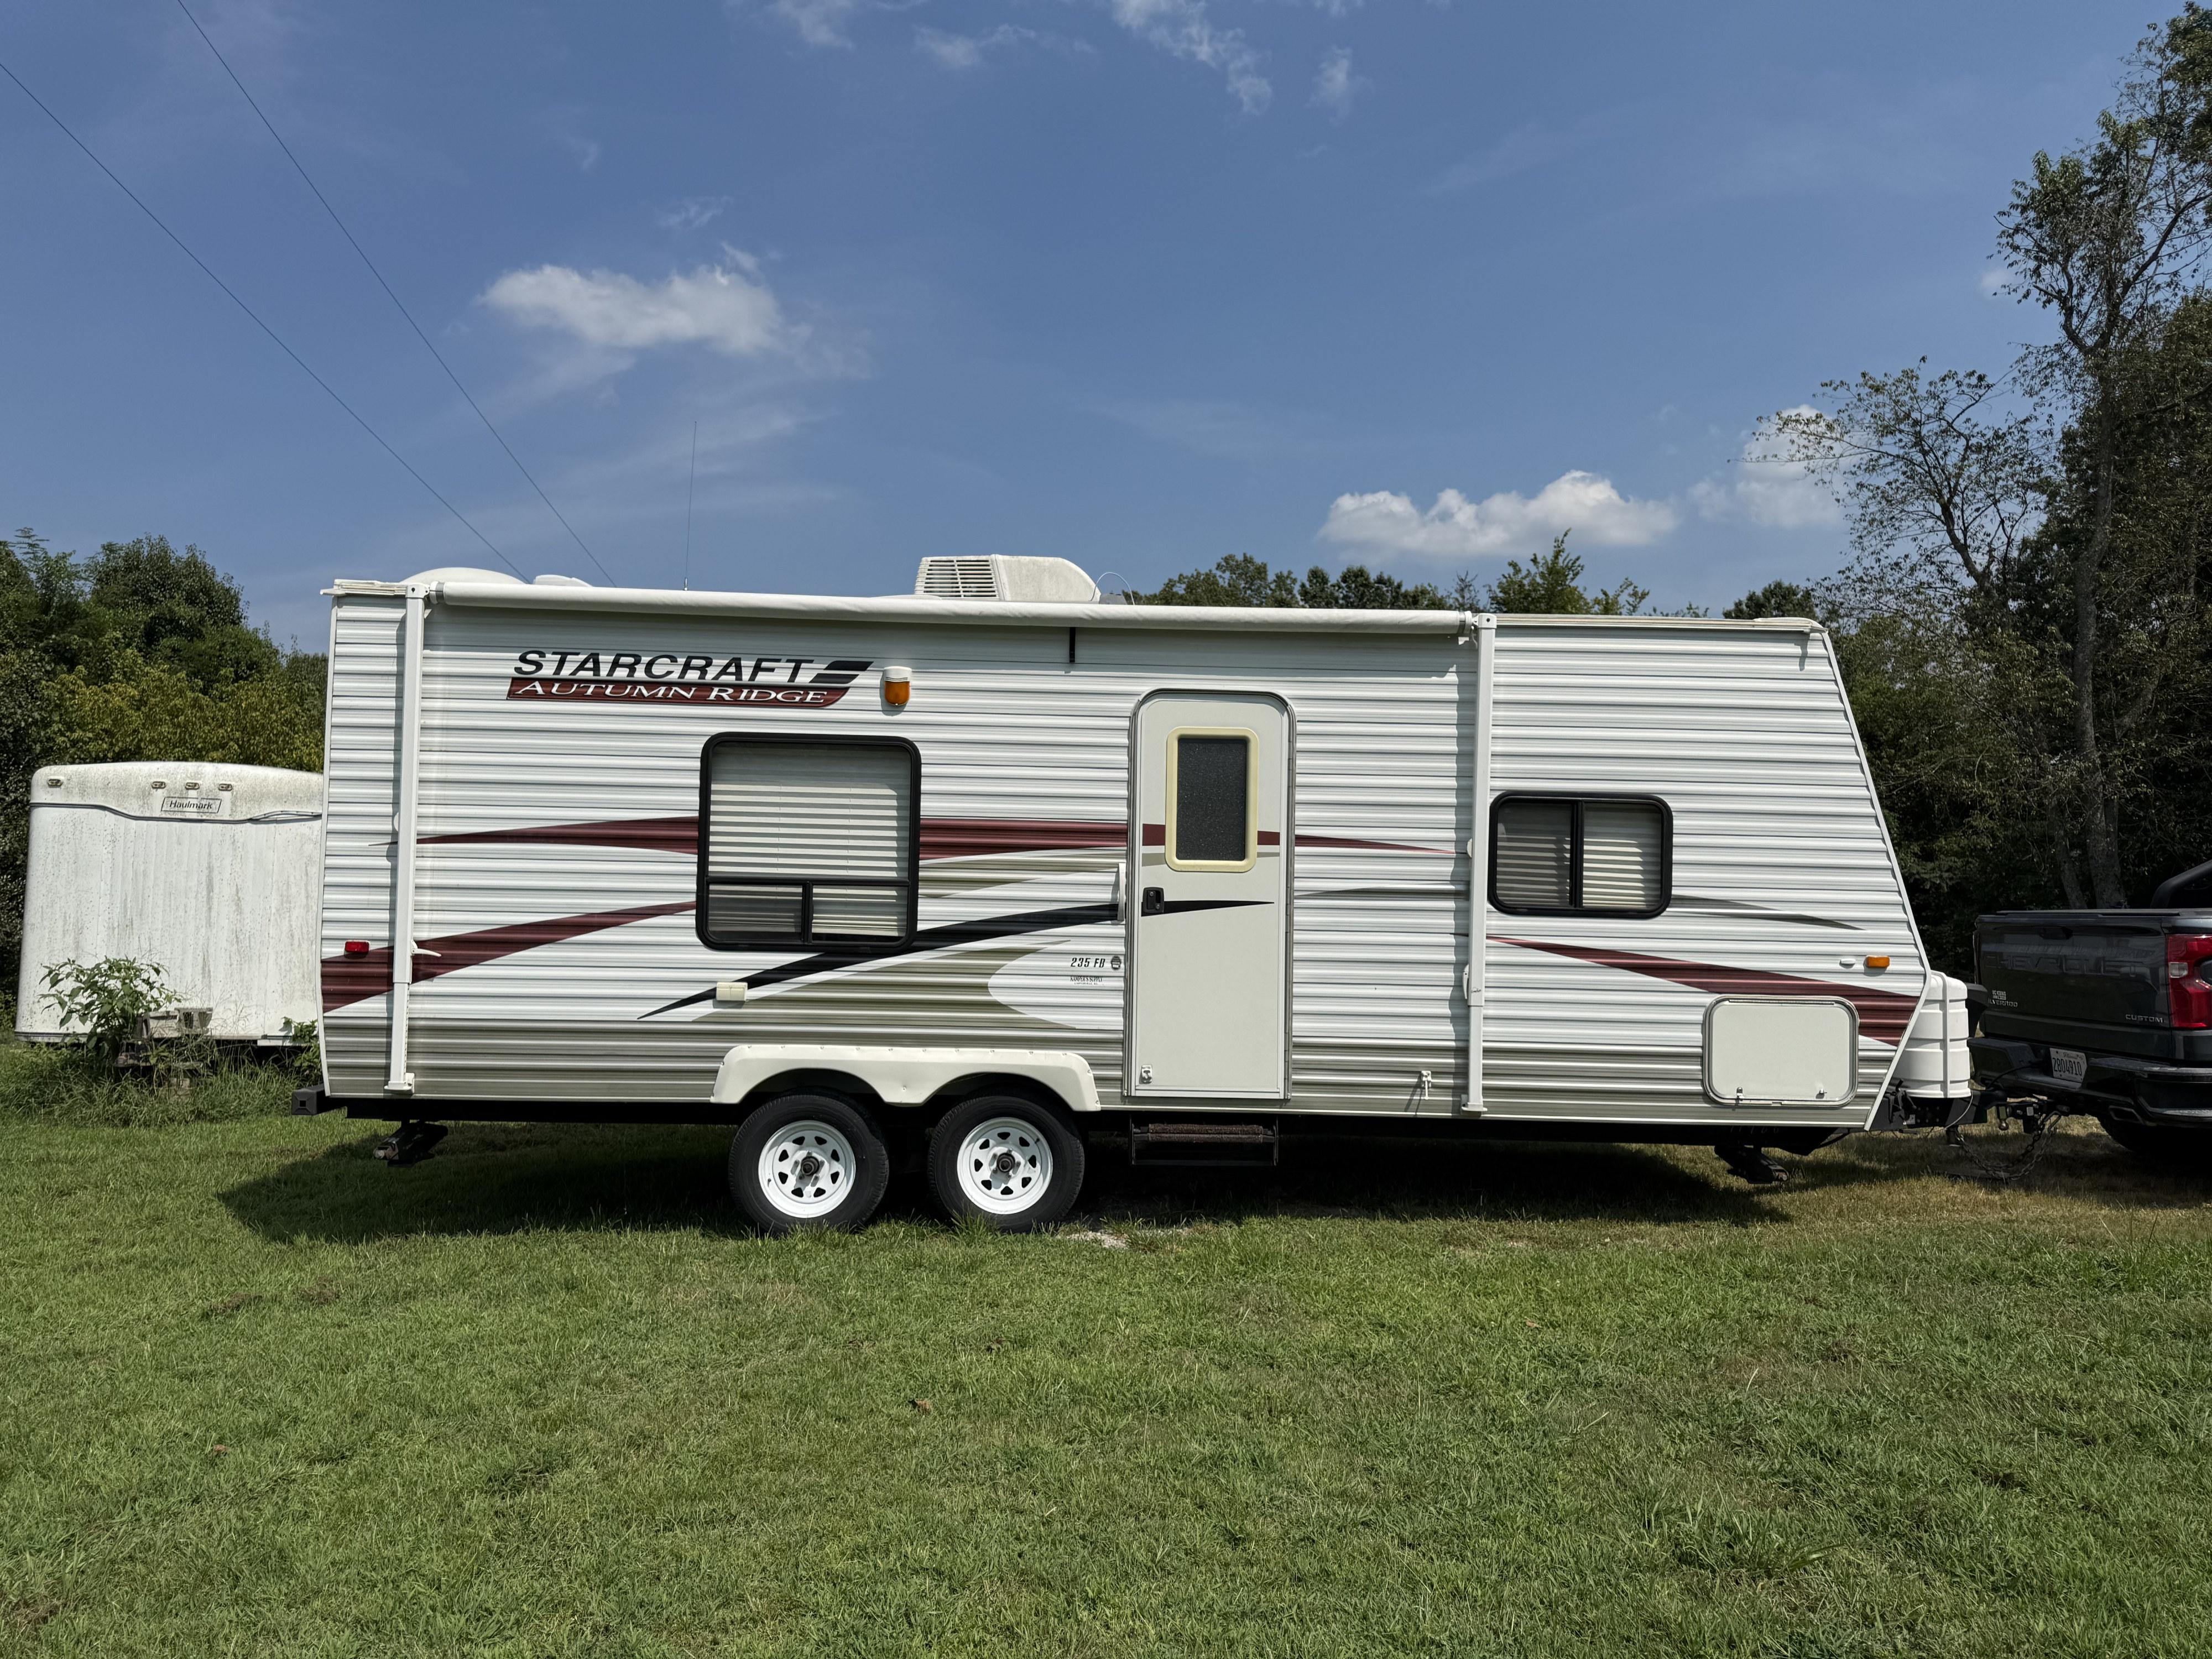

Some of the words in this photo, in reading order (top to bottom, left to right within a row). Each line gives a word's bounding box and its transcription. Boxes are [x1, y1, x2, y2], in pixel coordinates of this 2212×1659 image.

[514, 650, 814, 683] STARCRAFT
[515, 681, 705, 699] AUTUMN
[709, 686, 828, 703] RIDGE
[170, 800, 212, 809] Haulmark
[1071, 957, 1091, 967] 235
[1093, 958, 1105, 968] FB
[1988, 998, 2018, 1007] ILVERADO
[2125, 1014, 2163, 1023] CUSTOM
[2052, 1057, 2082, 1076] 2804910
